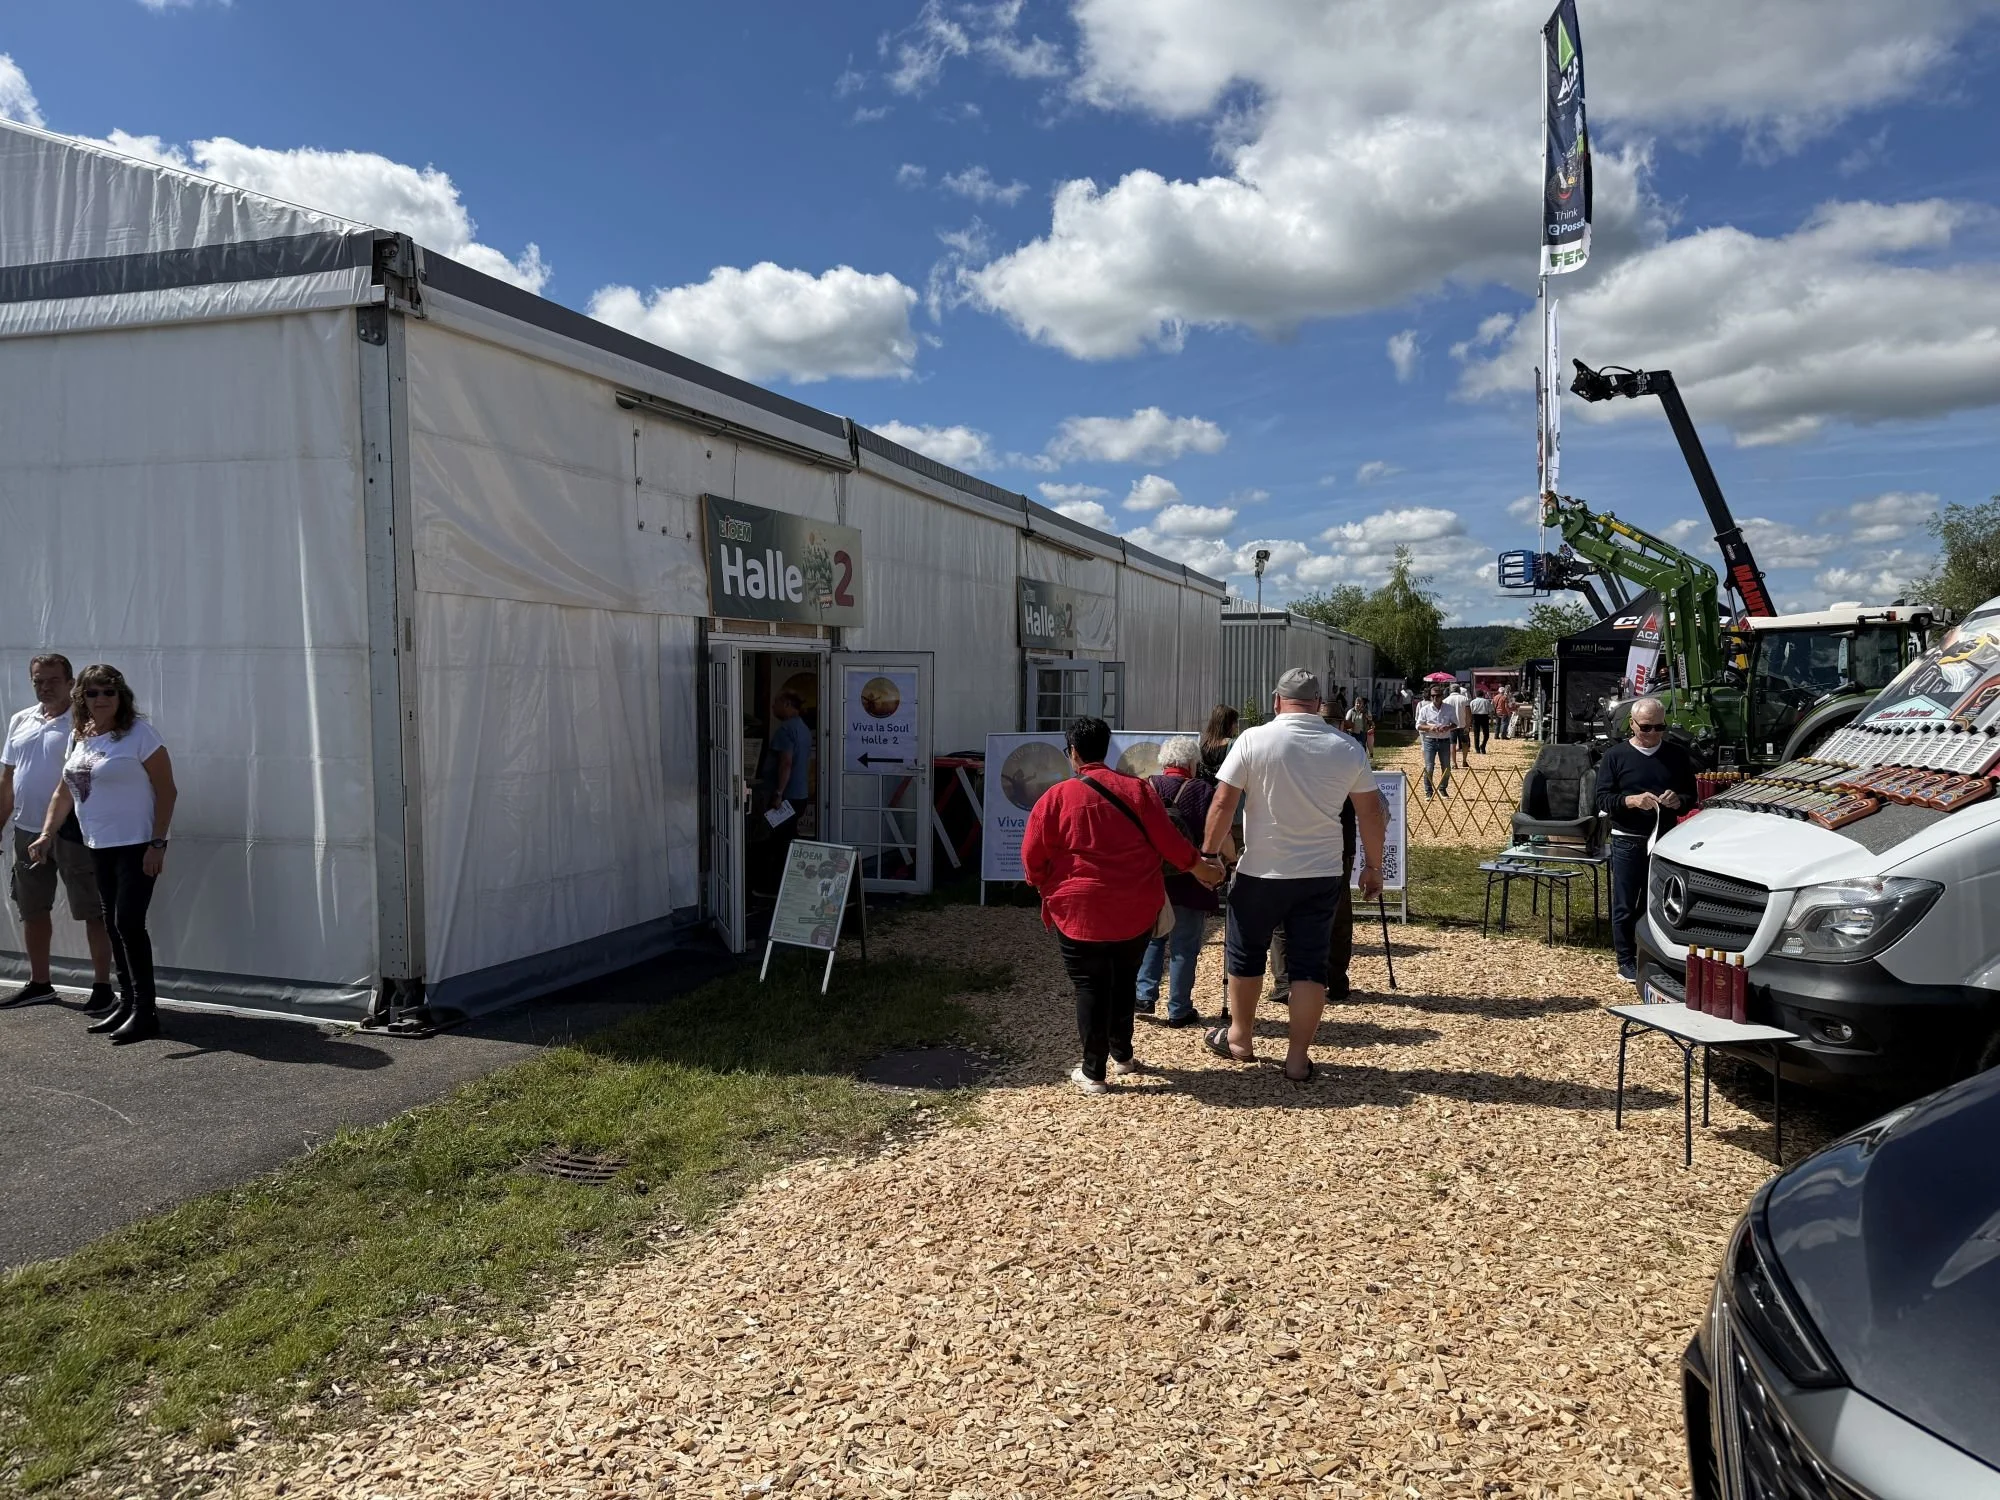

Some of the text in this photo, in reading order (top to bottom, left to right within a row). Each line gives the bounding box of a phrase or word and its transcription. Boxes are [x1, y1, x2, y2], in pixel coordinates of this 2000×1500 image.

[1554, 207, 1578, 221] Think
[1623, 557, 1652, 573] FENDT
[720, 543, 854, 607] Halle 2
[1024, 602, 1073, 638] Halle 2
[1636, 630, 1659, 641] ACA
[776, 656, 799, 667] Viva
[852, 722, 909, 733] Viva la Soul
[861, 735, 900, 745] Halle 2
[1380, 783, 1398, 791] Soul
[997, 816, 1025, 828] Viva
